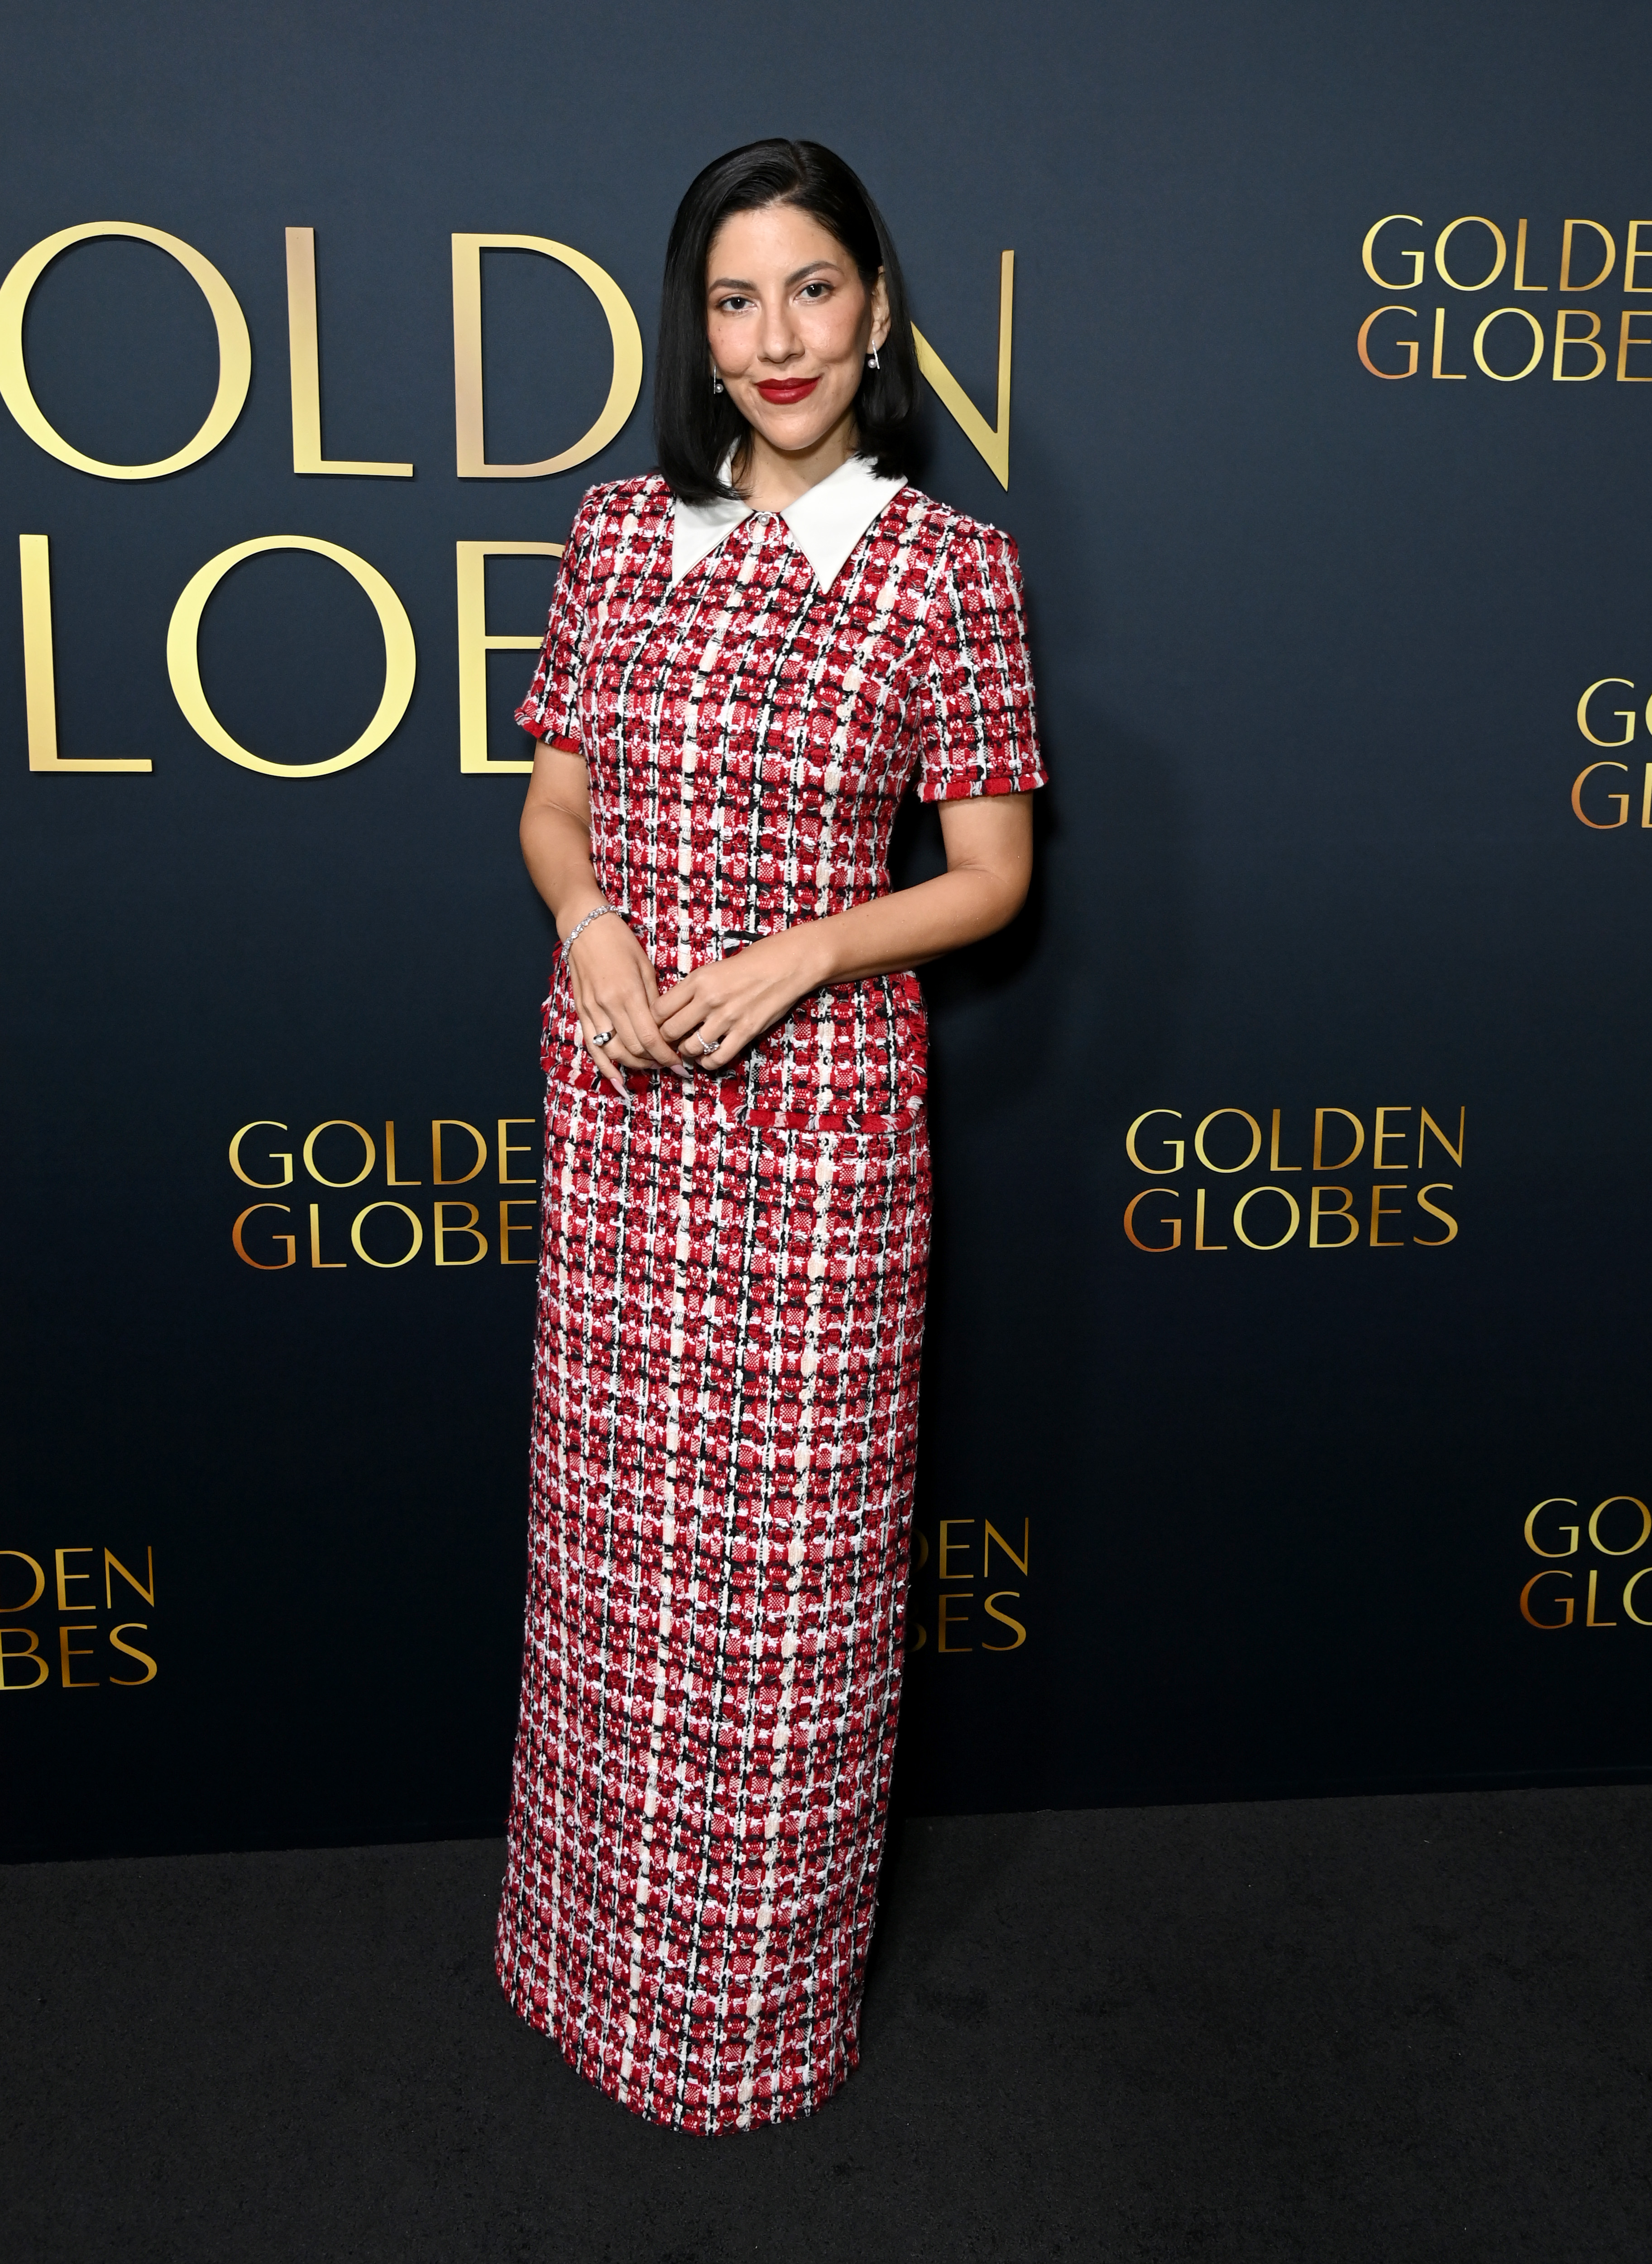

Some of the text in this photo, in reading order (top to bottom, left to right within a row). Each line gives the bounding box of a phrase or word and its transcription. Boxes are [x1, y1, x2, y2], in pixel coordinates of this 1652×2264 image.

[1577, 677, 1652, 747] G
[229, 1118, 537, 1189] GOLDE
[1125, 1106, 1465, 1174] GOLDEN
[232, 1200, 538, 1270] GLOBE
[1123, 1183, 1458, 1252] GLOBES
[1524, 1496, 1652, 1558] GO
